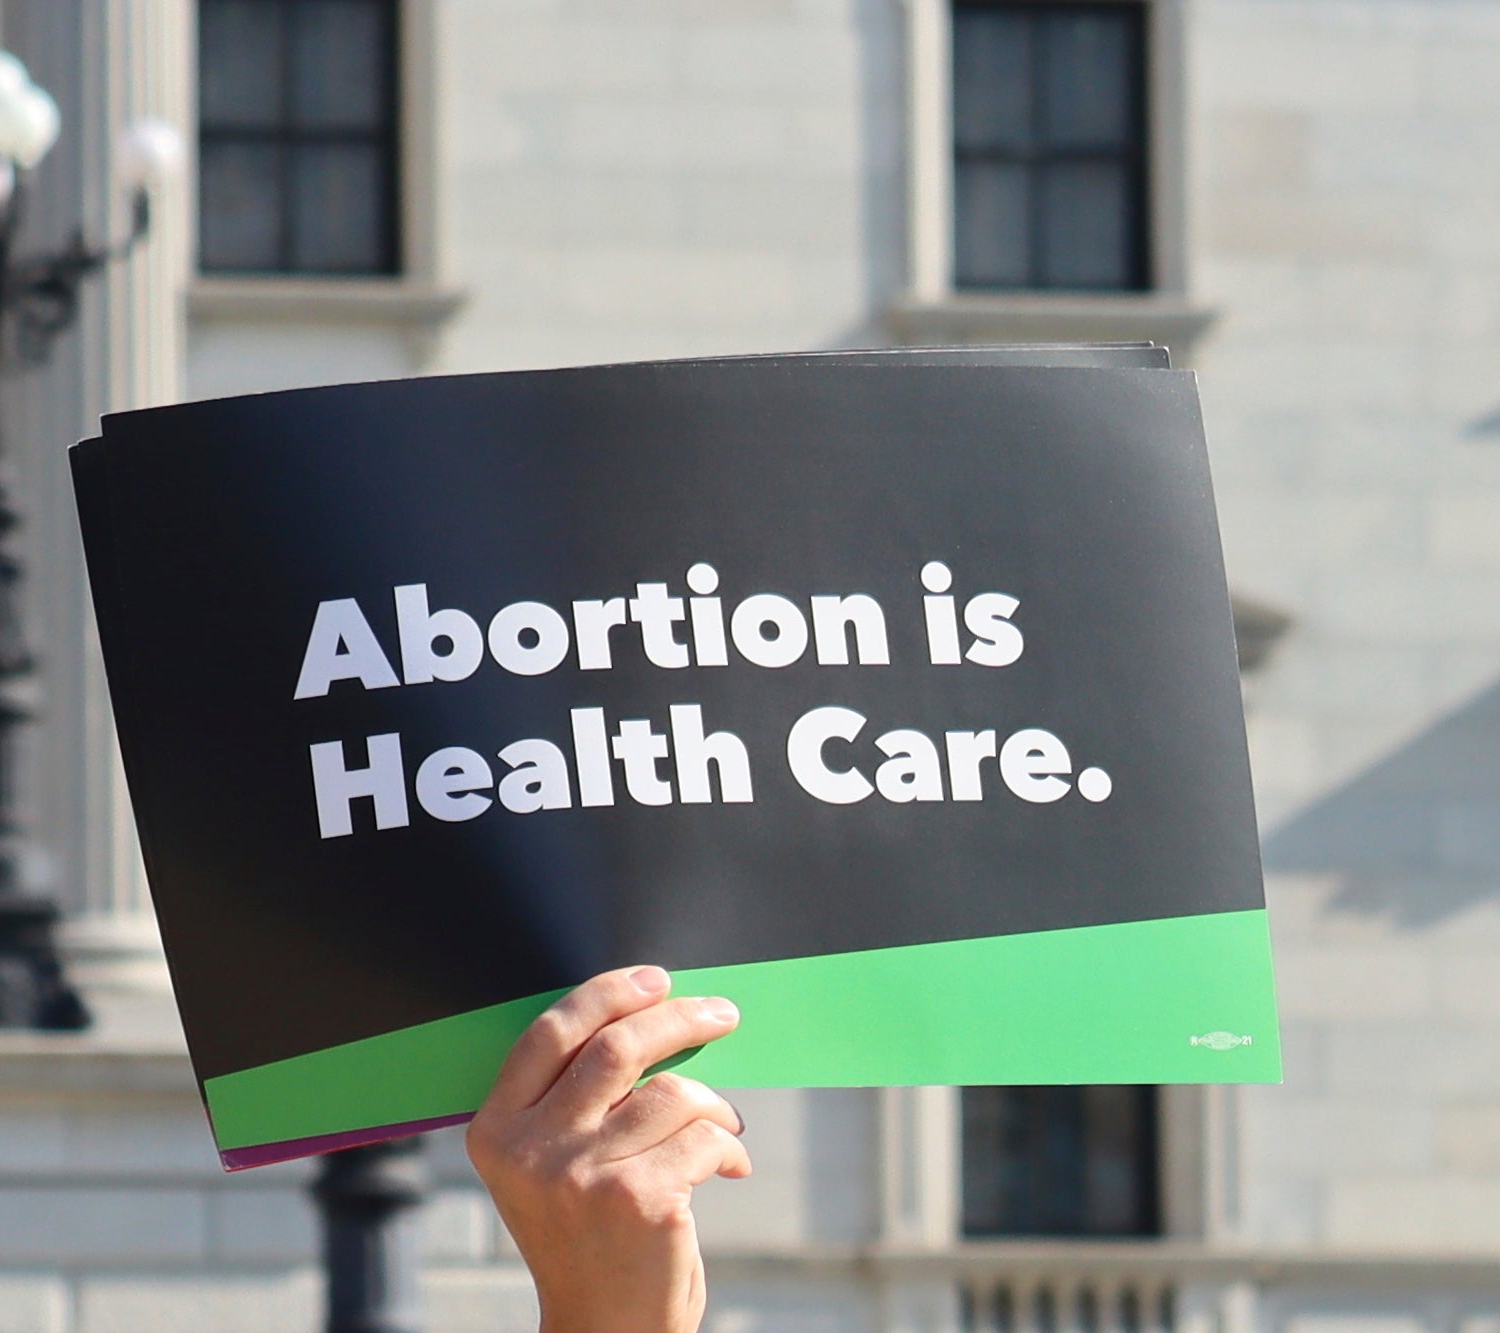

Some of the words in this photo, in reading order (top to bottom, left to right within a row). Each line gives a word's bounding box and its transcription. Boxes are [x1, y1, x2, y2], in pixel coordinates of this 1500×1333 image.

[293, 562, 890, 702] Abortion
[920, 560, 1025, 668] is
[309, 703, 754, 841] Health
[786, 705, 1113, 805] Care.
